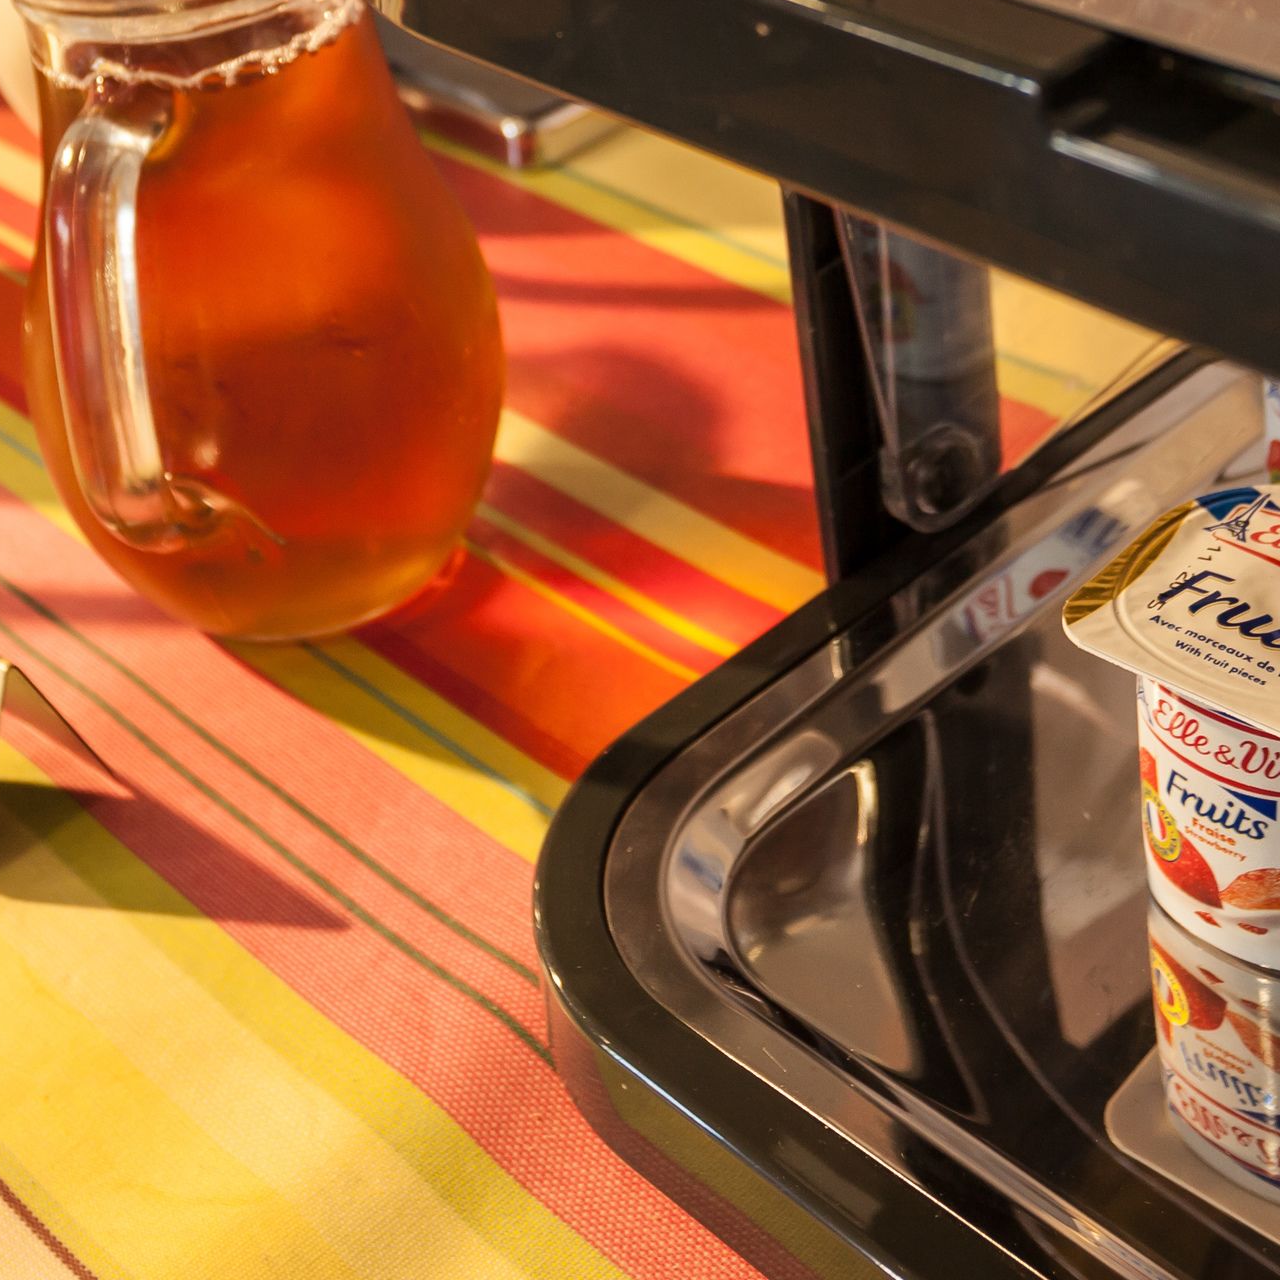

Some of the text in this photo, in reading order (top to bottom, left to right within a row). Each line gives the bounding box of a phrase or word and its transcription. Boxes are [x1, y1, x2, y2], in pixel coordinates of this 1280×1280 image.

[1149, 614, 1183, 633] Avec
[1184, 628, 1254, 663] morceaux
[1256, 658, 1275, 674] de
[1174, 639, 1268, 687] With fruit pieces
[1152, 698, 1211, 755] Elle
[1213, 742, 1240, 769] &
[1165, 769, 1269, 841] Fruits
[1190, 816, 1238, 847] Fraise
[1184, 826, 1247, 862] Strawberry
